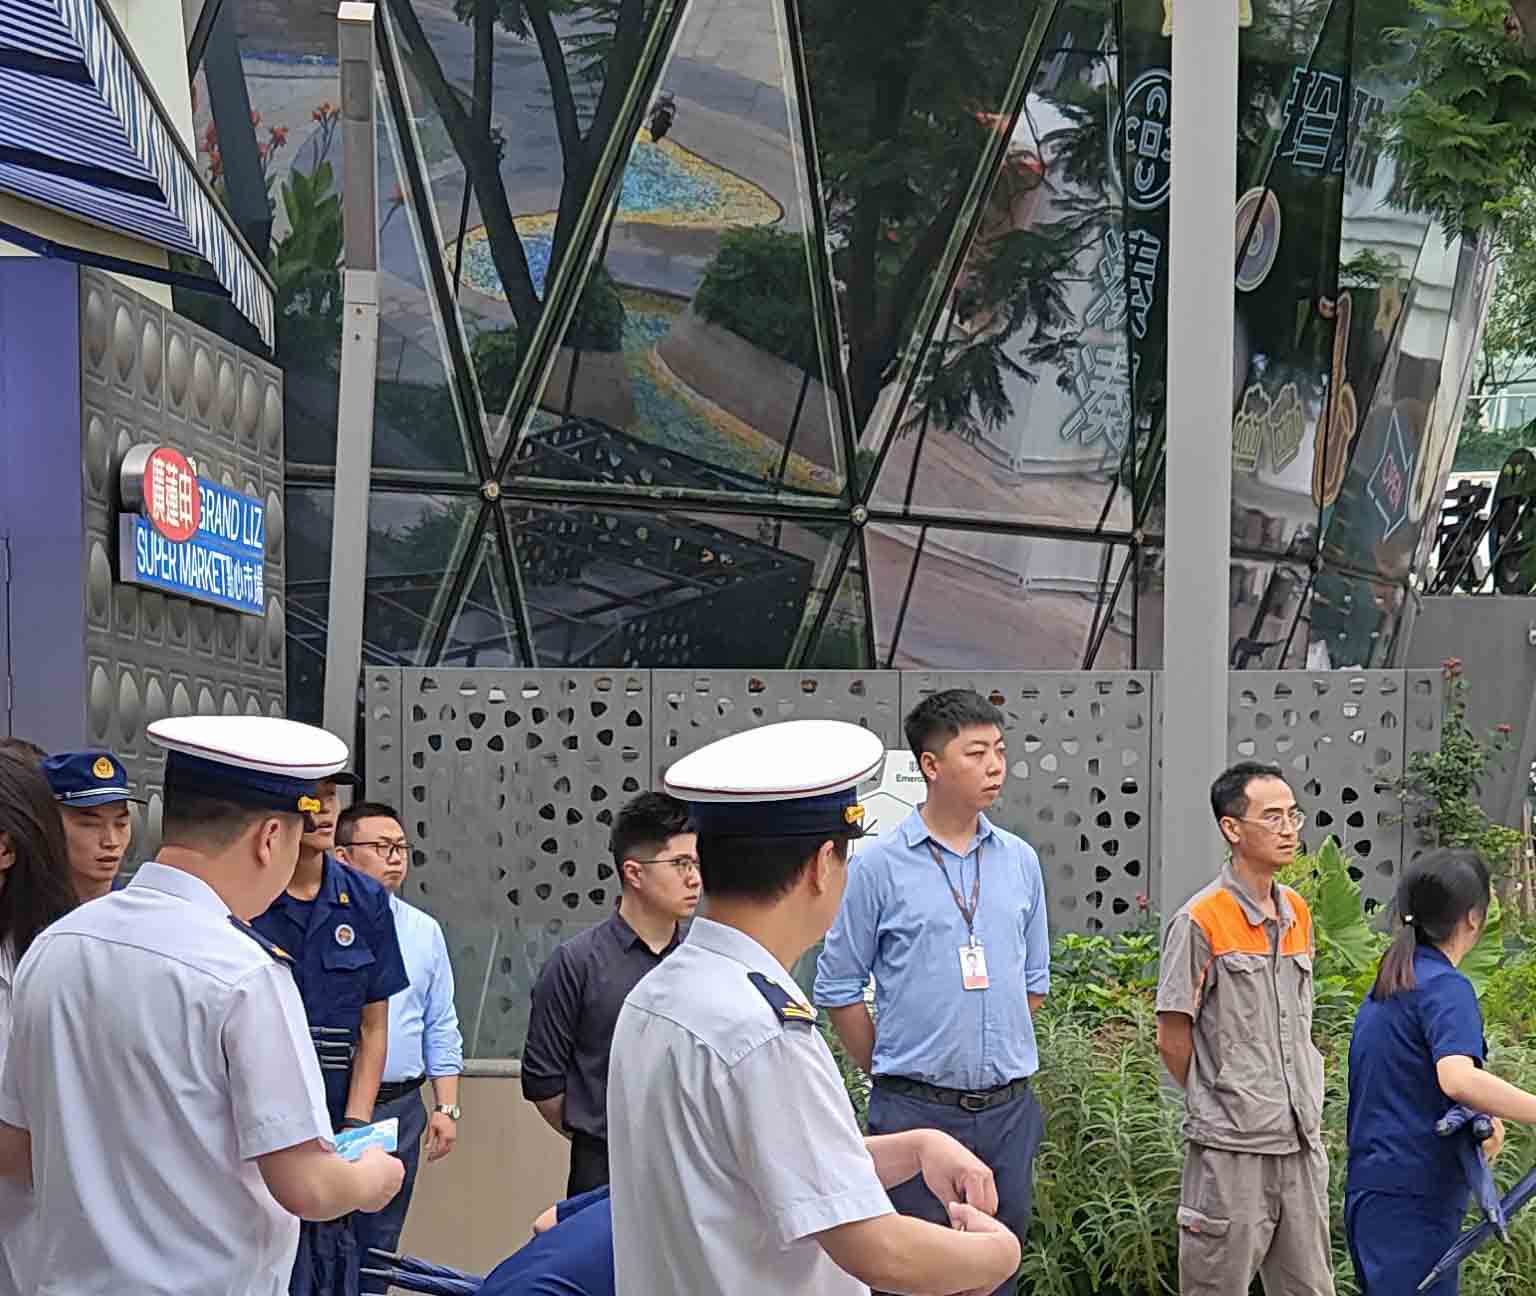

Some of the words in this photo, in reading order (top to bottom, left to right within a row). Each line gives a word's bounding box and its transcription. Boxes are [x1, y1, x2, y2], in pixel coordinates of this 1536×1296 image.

[199, 486, 241, 541] GRAND
[243, 503, 263, 549] LIZ
[136, 526, 177, 581] SUPER
[179, 543, 231, 597] MARKET
